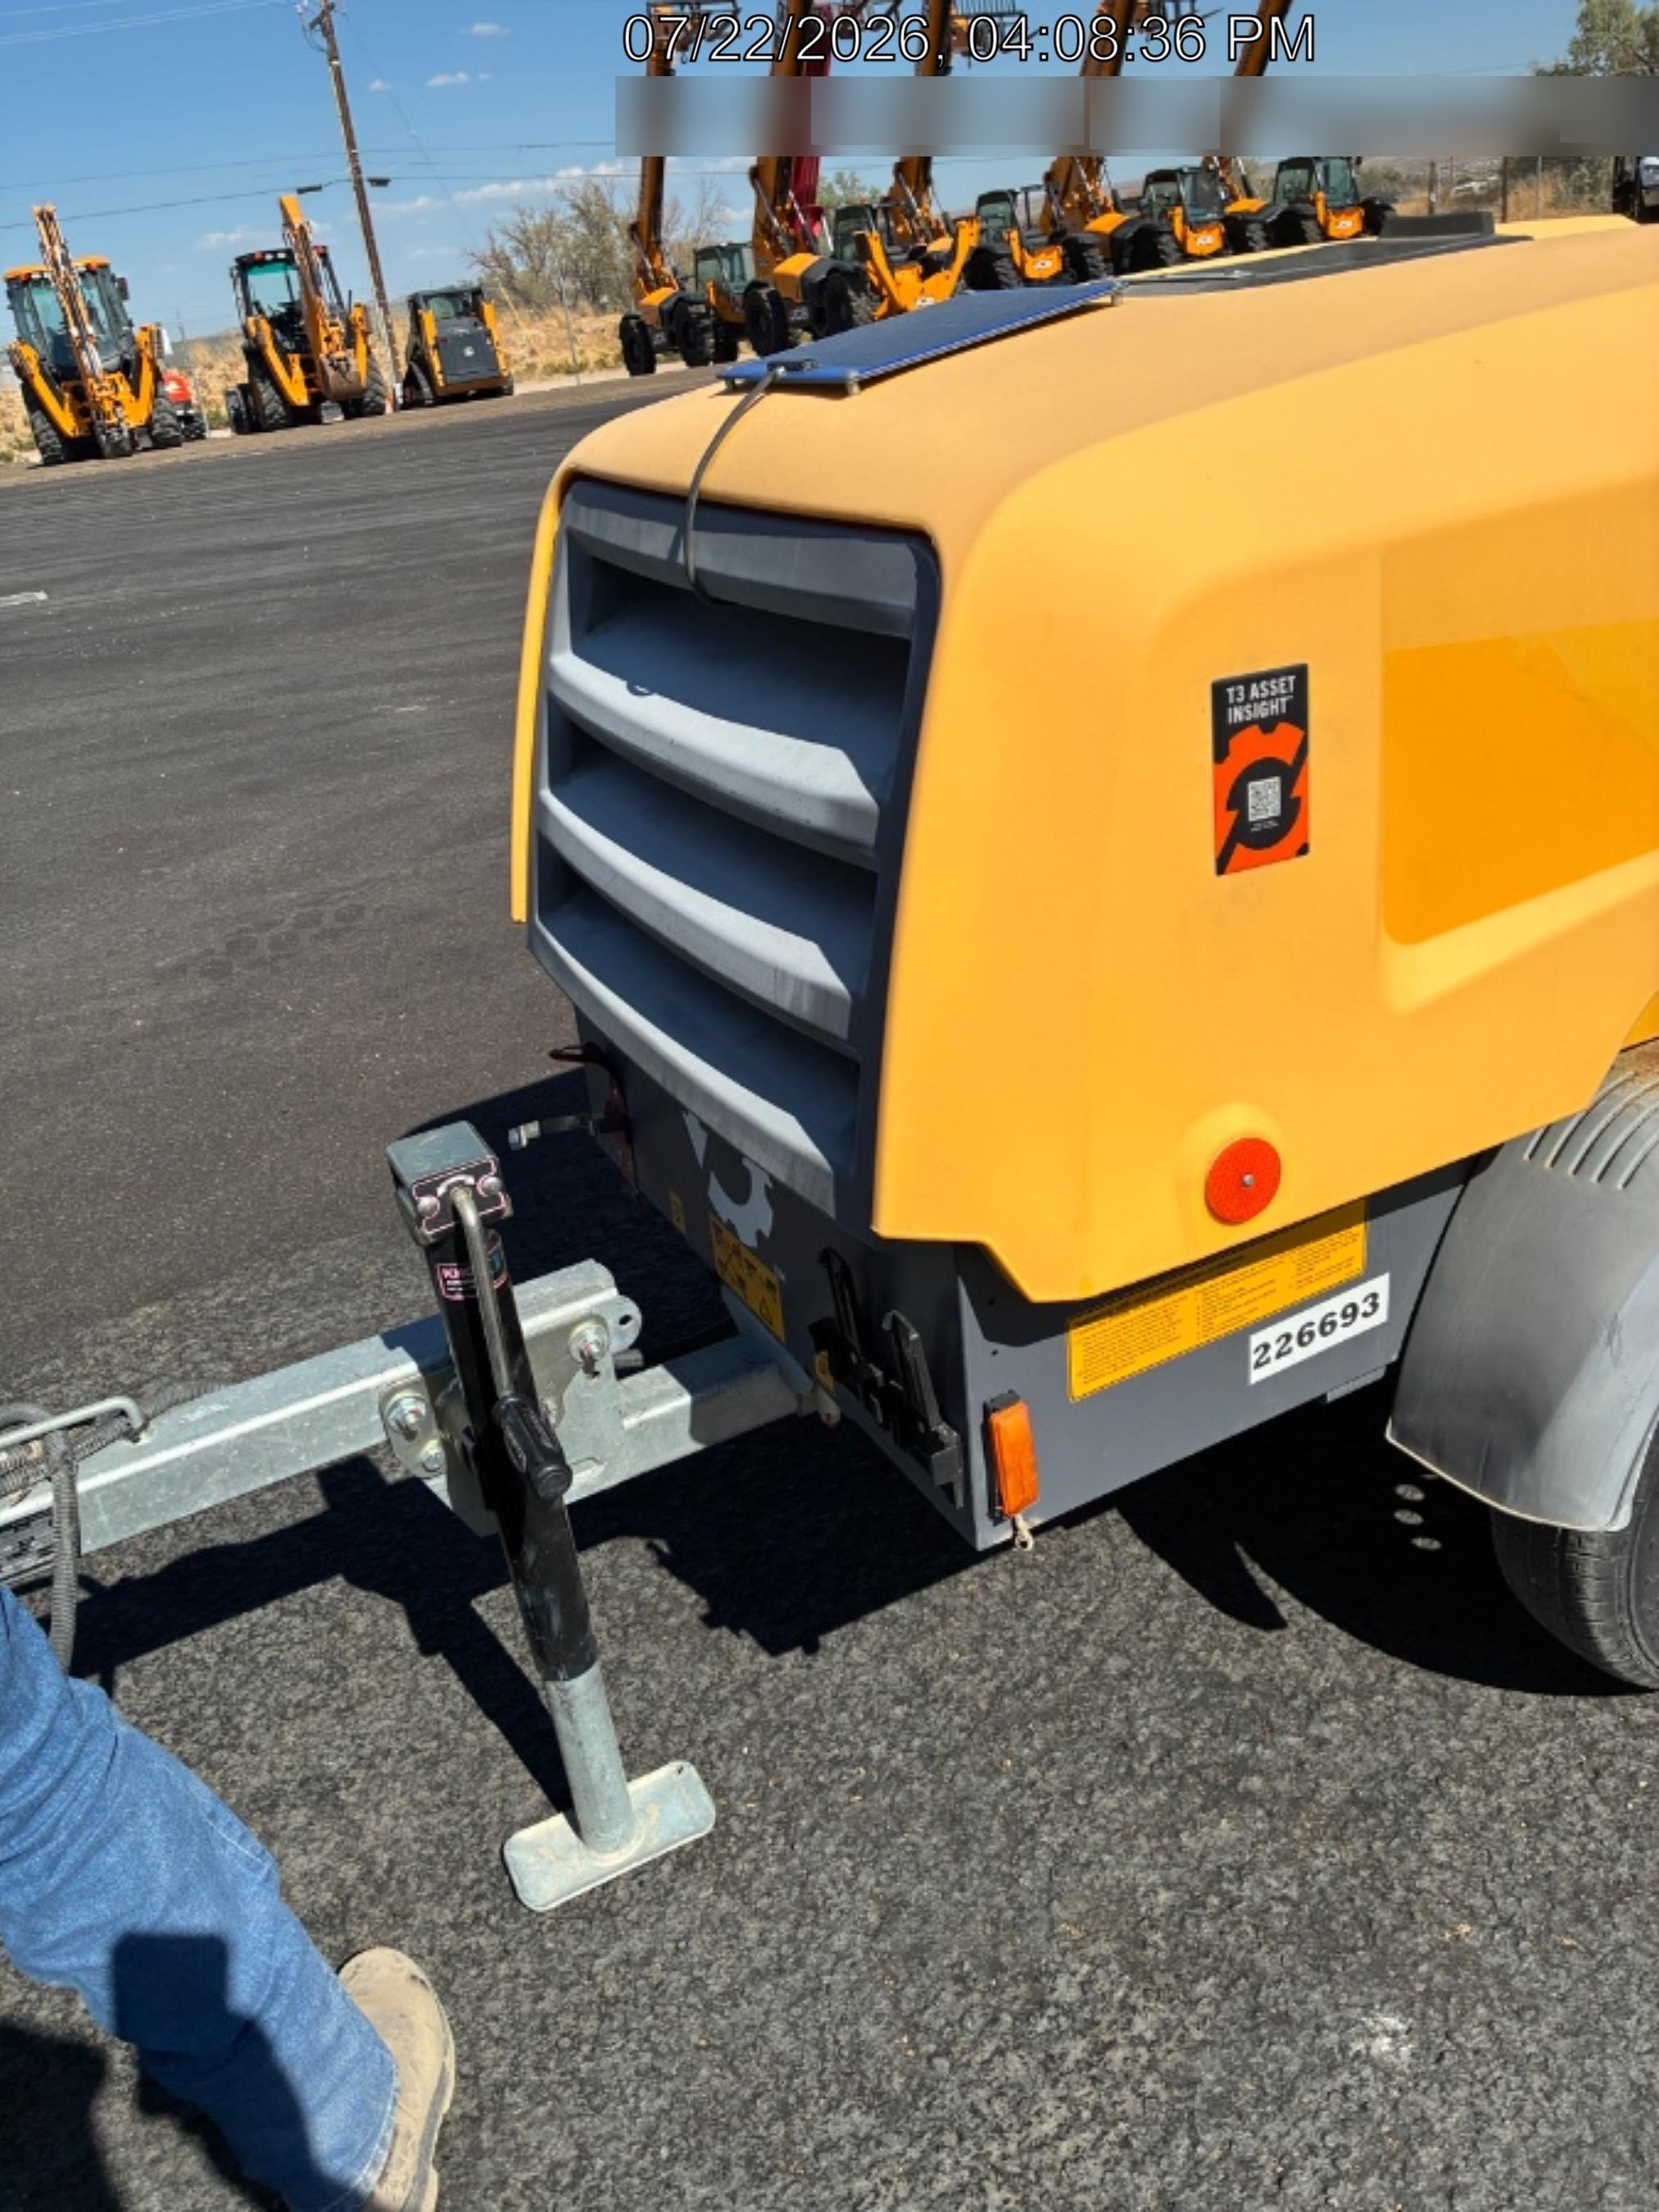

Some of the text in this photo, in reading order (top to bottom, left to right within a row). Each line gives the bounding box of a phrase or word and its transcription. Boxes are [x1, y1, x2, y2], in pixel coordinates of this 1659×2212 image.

[1226, 675, 1296, 704] T3 ASSET
[1253, 1291, 1380, 1370] 226693
